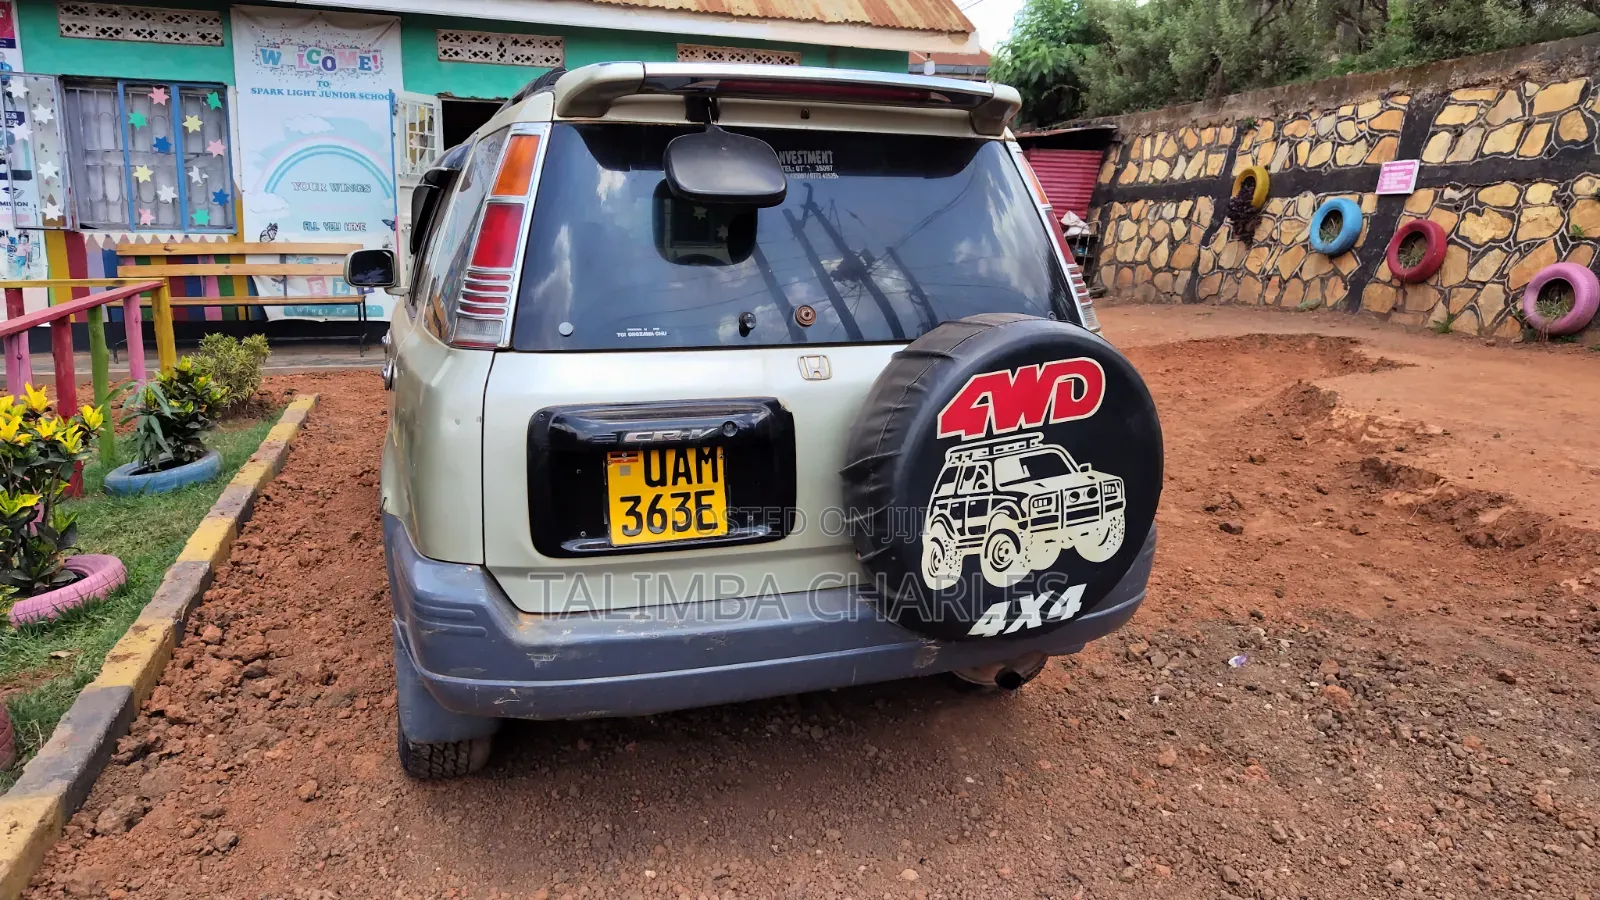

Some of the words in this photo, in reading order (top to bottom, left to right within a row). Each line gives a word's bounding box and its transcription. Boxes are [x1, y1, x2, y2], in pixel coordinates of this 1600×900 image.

[260, 48, 380, 71] WLCOME!
[317, 80, 330, 88] TO
[251, 87, 284, 95] SPARK
[287, 89, 316, 97] LIGHT
[319, 90, 356, 99] JUNIOR
[359, 92, 390, 100] SCHOO
[779, 150, 833, 164] NVESTMENT
[291, 181, 327, 192] YOUR
[329, 182, 371, 193] WINGS
[303, 220, 320, 231] ALL
[323, 221, 341, 231] YOU
[344, 222, 366, 232] HAVE
[937, 356, 1106, 441] 4WD
[624, 427, 718, 443] CR-V
[643, 446, 719, 487] UAM
[619, 490, 719, 537] 363E
[967, 583, 1087, 638] 4X4
